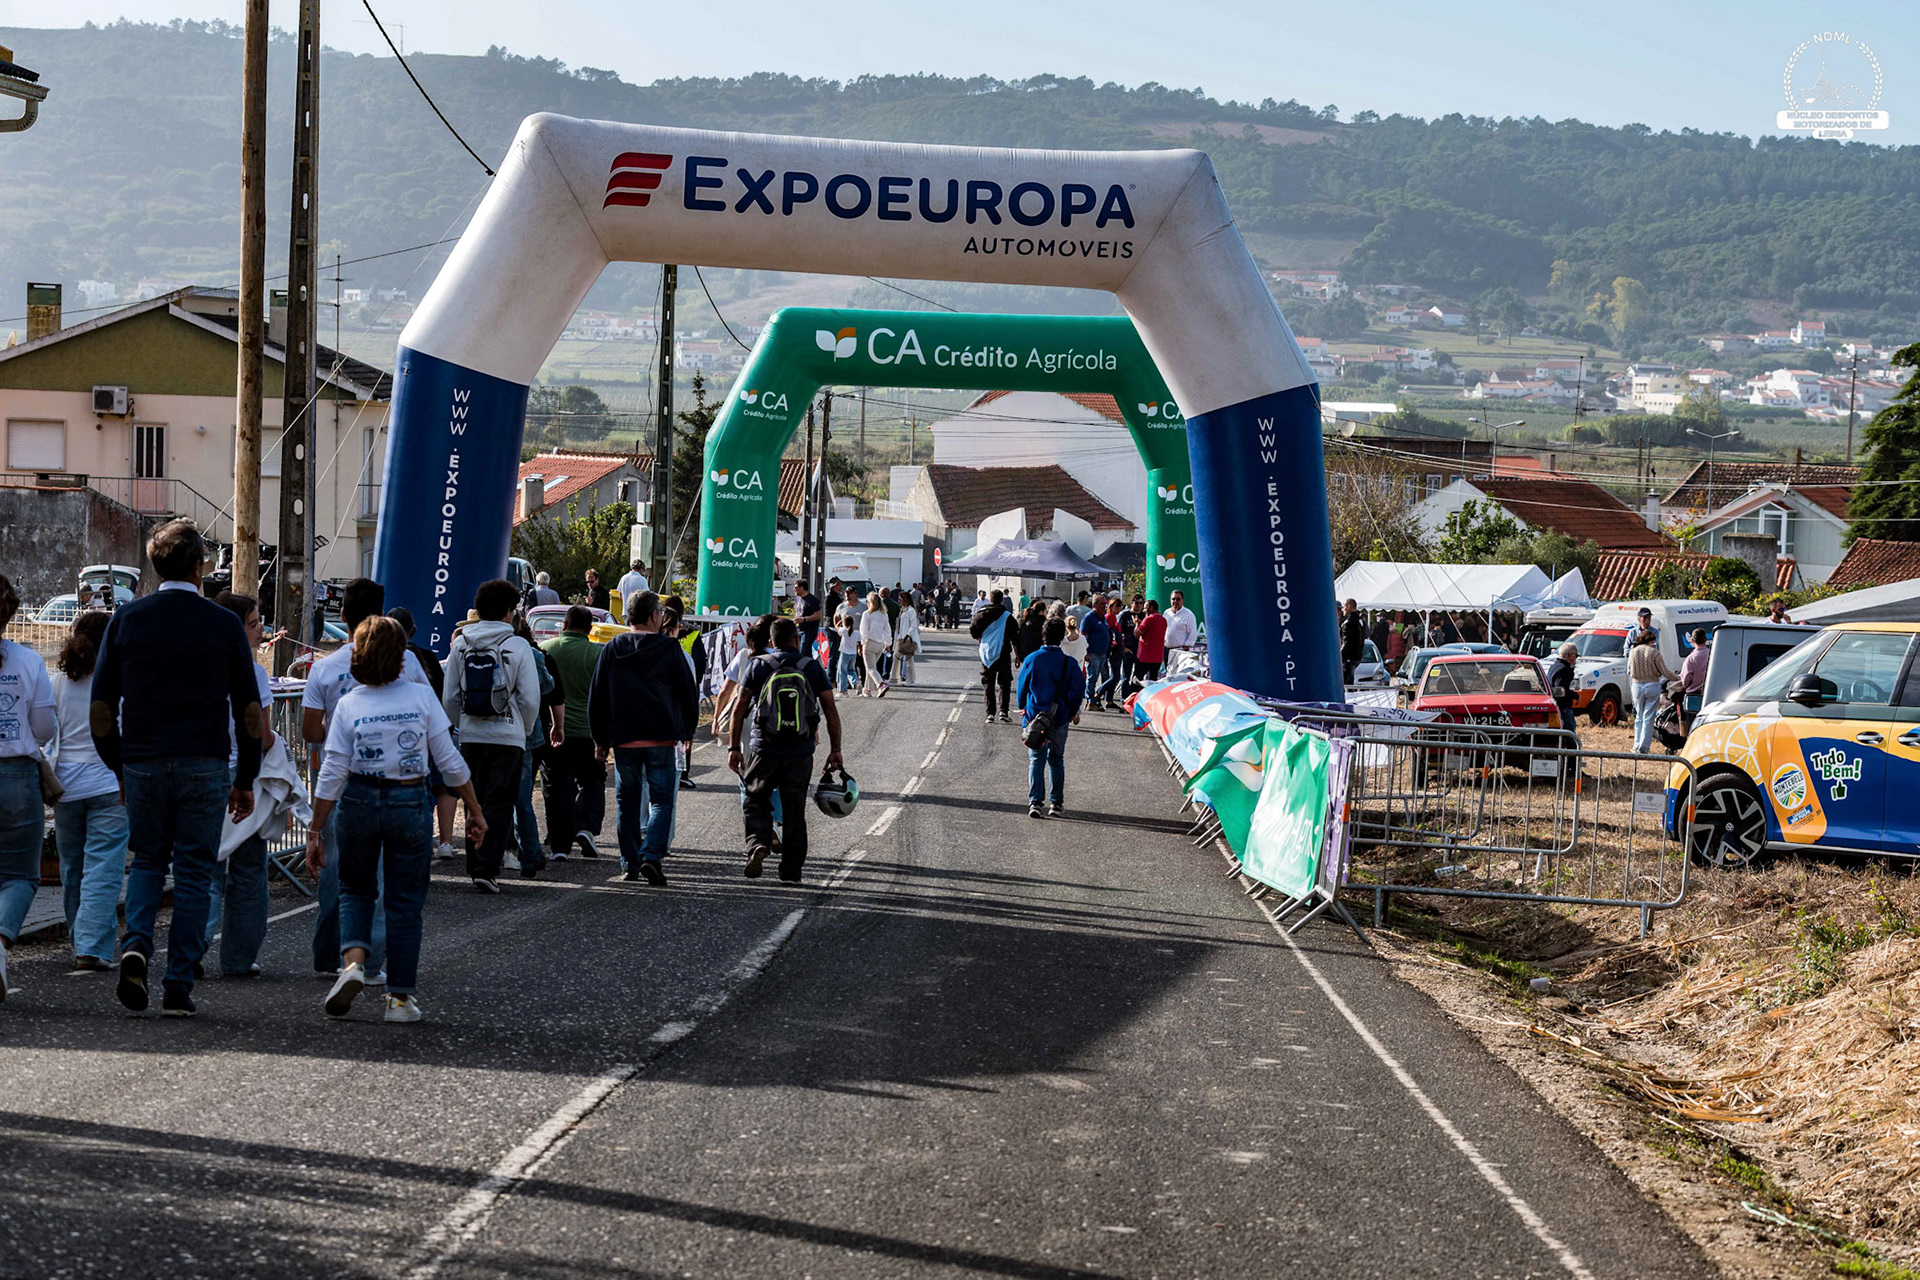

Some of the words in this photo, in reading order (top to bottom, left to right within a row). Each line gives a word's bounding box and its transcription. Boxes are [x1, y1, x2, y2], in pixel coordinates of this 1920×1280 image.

[683, 155, 1136, 229] EXPOEUROPA
[867, 328, 926, 366] CA
[934, 345, 1018, 368] Crédito
[1025, 348, 1117, 374] Agrícola
[761, 391, 788, 411] CA
[743, 409, 764, 418] Crédito
[733, 470, 763, 491] CA
[729, 538, 758, 558] CA
[712, 560, 733, 568] Crédito
[362, 713, 420, 724] EXPOEUROPA
[1811, 750, 1844, 769] Tudo
[1822, 760, 1861, 779] Bem!
